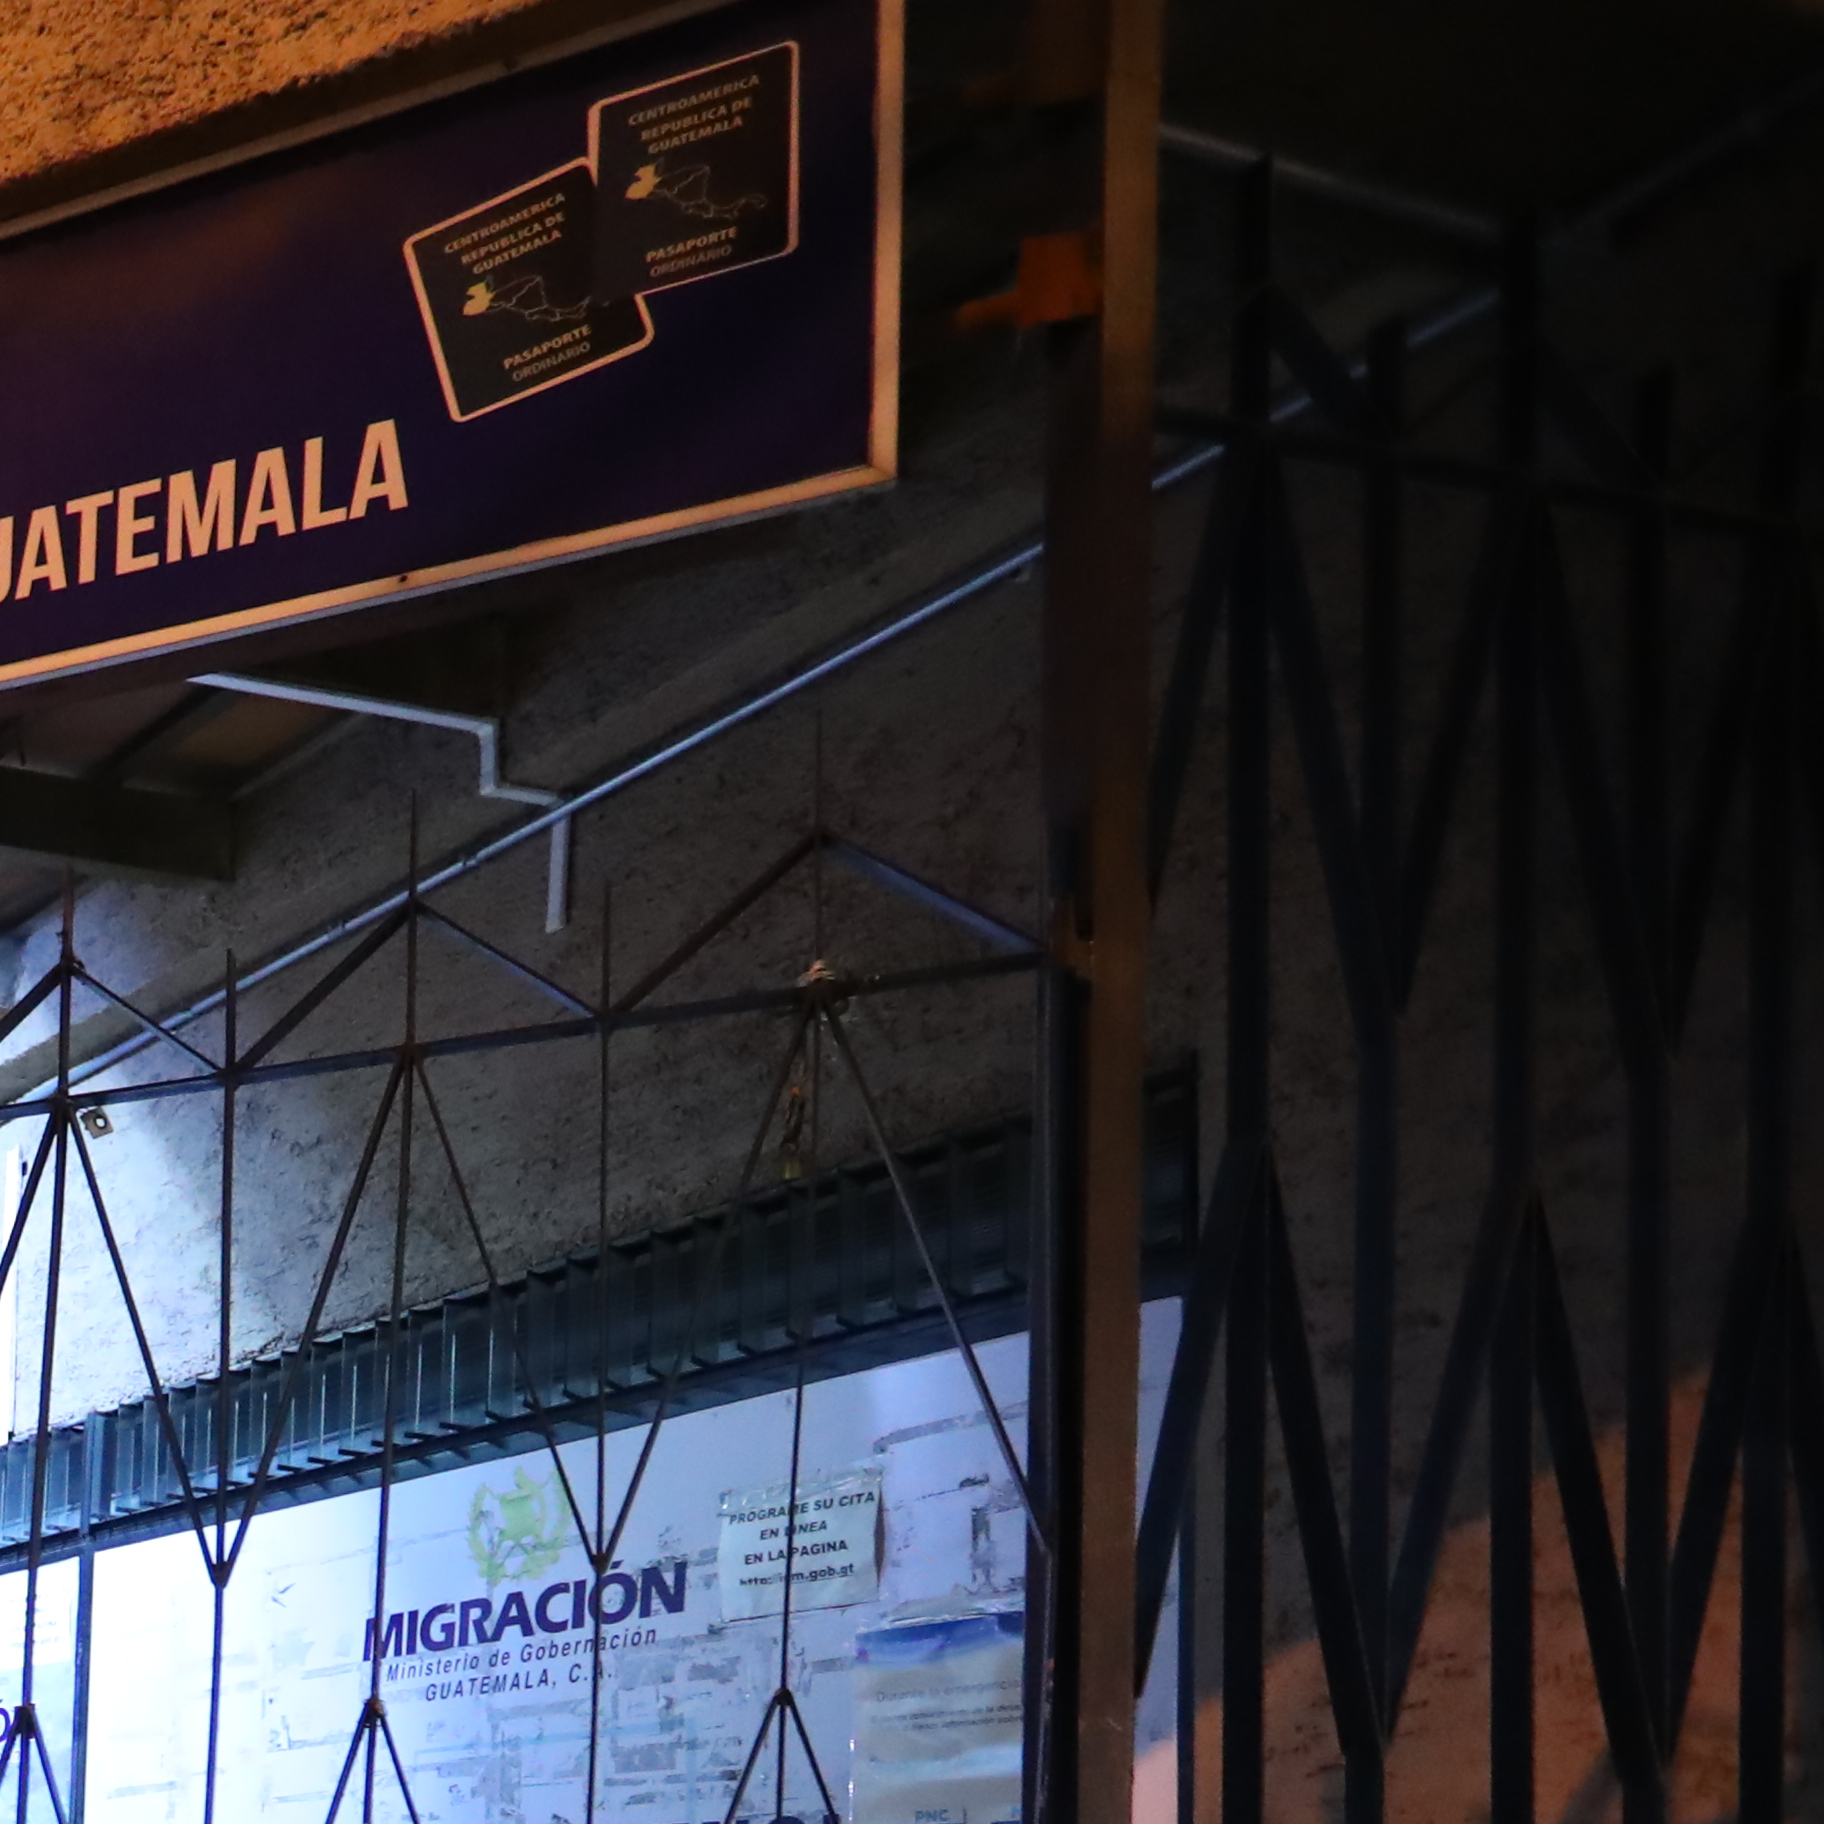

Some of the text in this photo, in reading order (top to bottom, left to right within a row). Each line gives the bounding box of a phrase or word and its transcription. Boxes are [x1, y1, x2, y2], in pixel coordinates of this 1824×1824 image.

[628, 75, 760, 126] CENTROAMERICA
[640, 97, 751, 141] REPUBLICA DE
[648, 116, 743, 154] GUATEMALA
[444, 193, 566, 254] CENTROAMERICA
[461, 212, 565, 265] REPUBLICA DE
[473, 230, 562, 275] GUATEMALA
[646, 226, 737, 263] PASAPORTE
[650, 245, 732, 277] ORDINARIO
[503, 324, 592, 369] PASAPORTE
[512, 342, 591, 382] ORDINARIO
[813, 1498, 833, 1511] SU
[839, 1491, 875, 1507] CITA
[745, 1540, 848, 1565] EN LA PAGINA
[760, 1529, 780, 1540] EN
[362, 1560, 688, 1662] MIGRACIÓN
[387, 1628, 657, 1682] Ministerio de Gobernación
[425, 1668, 557, 1702] GUATEMALA,
[914, 1809, 949, 1823] PNC
